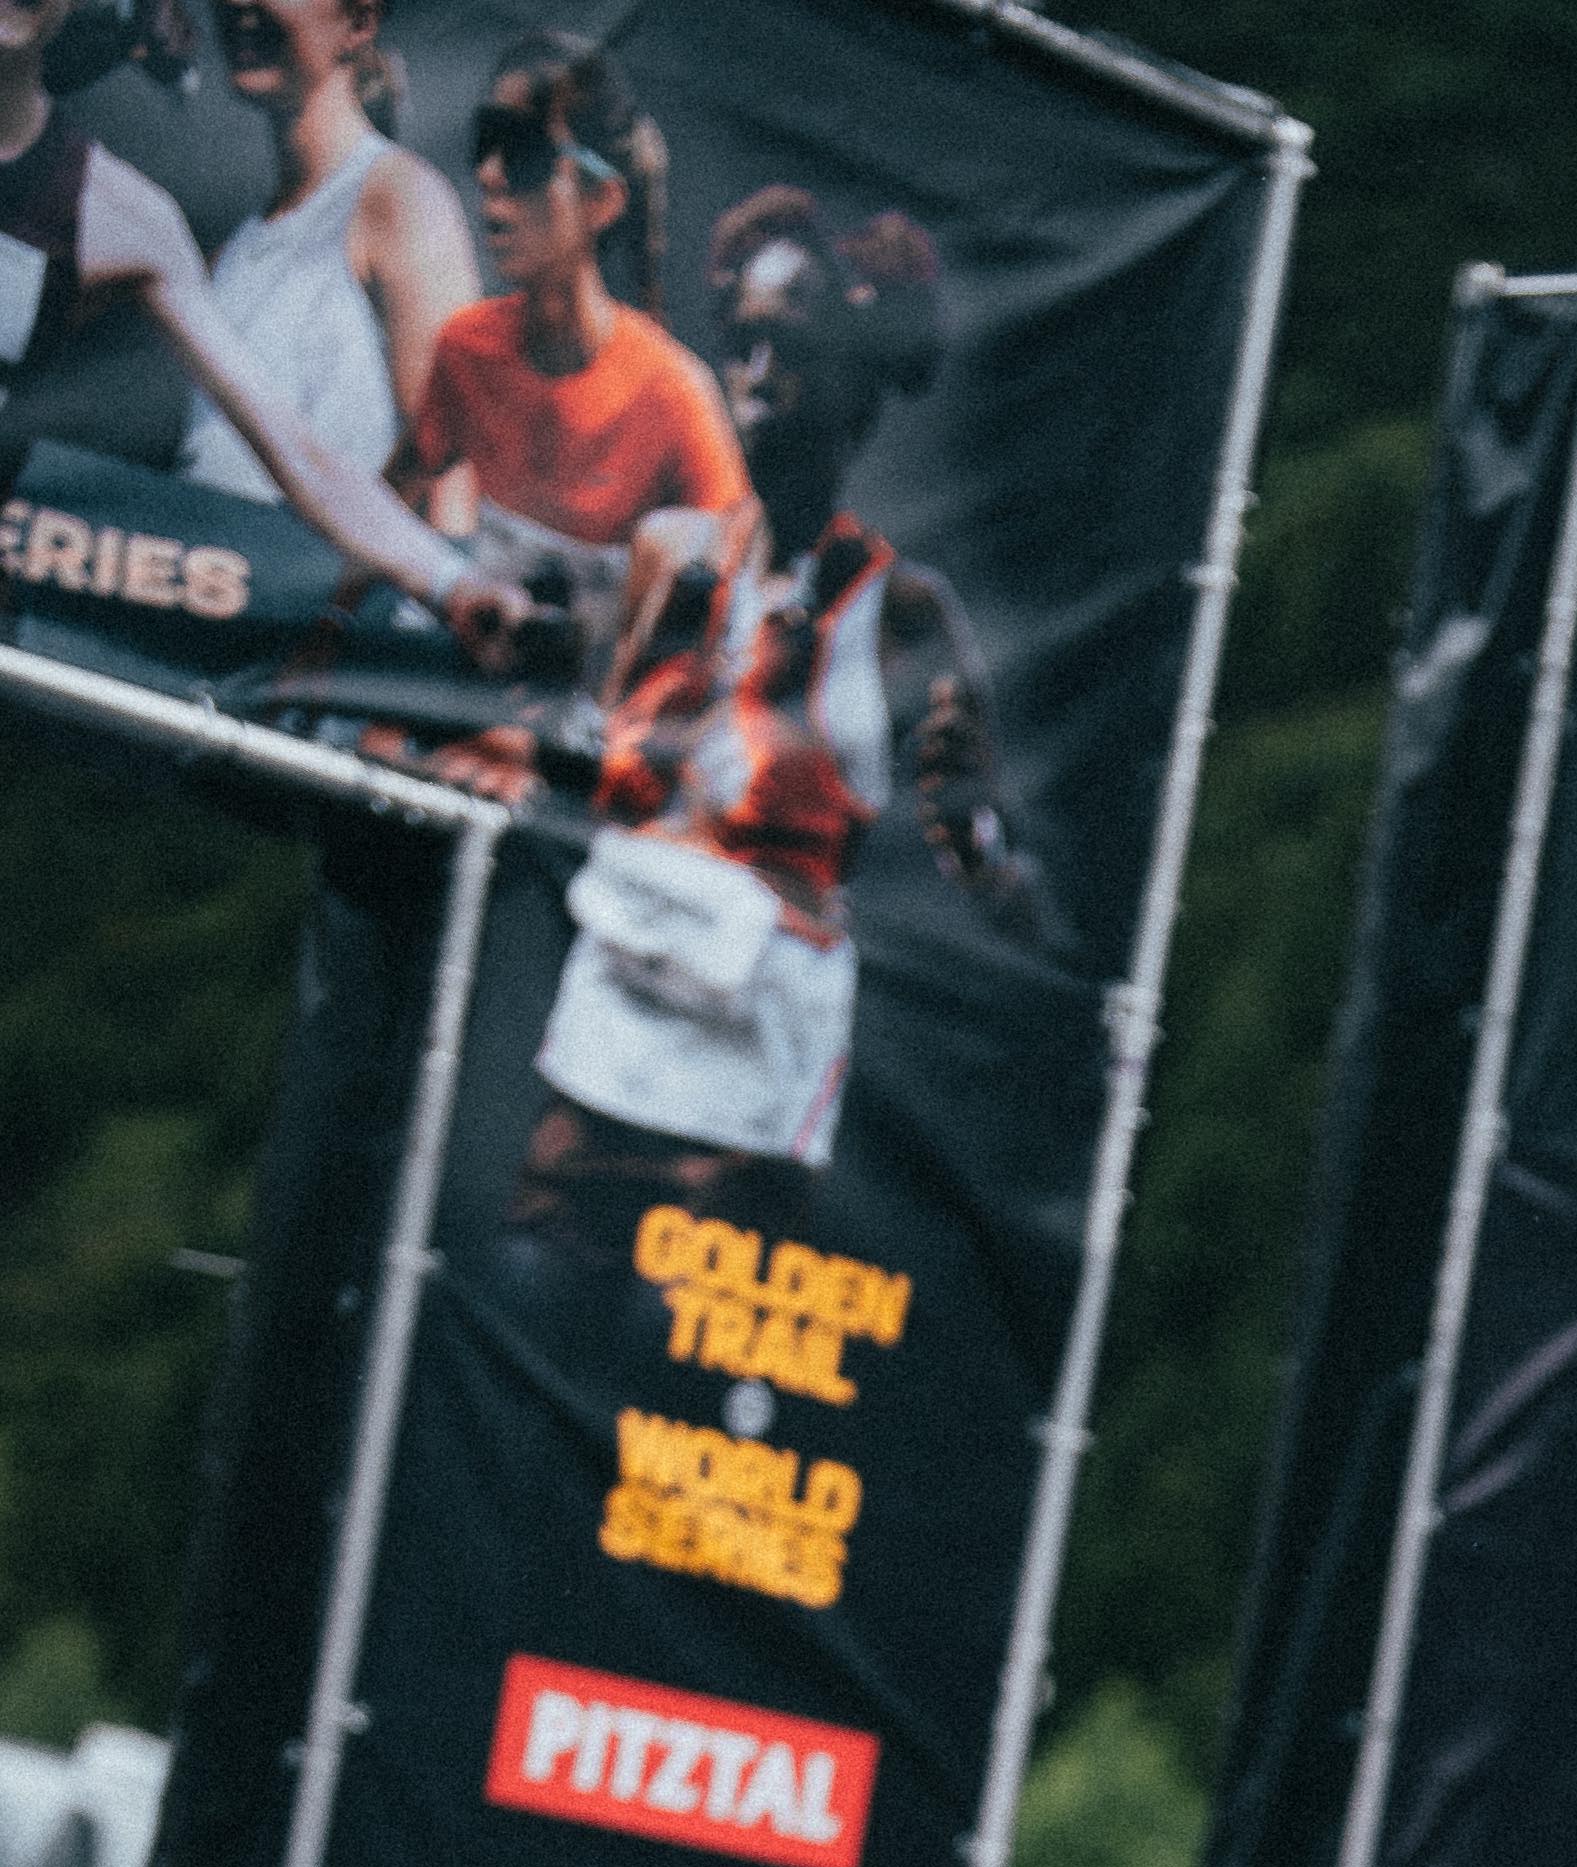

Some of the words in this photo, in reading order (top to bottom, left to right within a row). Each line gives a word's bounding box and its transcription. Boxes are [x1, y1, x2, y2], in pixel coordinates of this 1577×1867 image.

[633, 1204, 912, 1346] GOLDEN
[660, 1283, 857, 1407] TRAIL
[616, 1407, 863, 1531] WORLD
[599, 1482, 847, 1609] SERIES
[521, 1689, 844, 1844] PITZTAL
